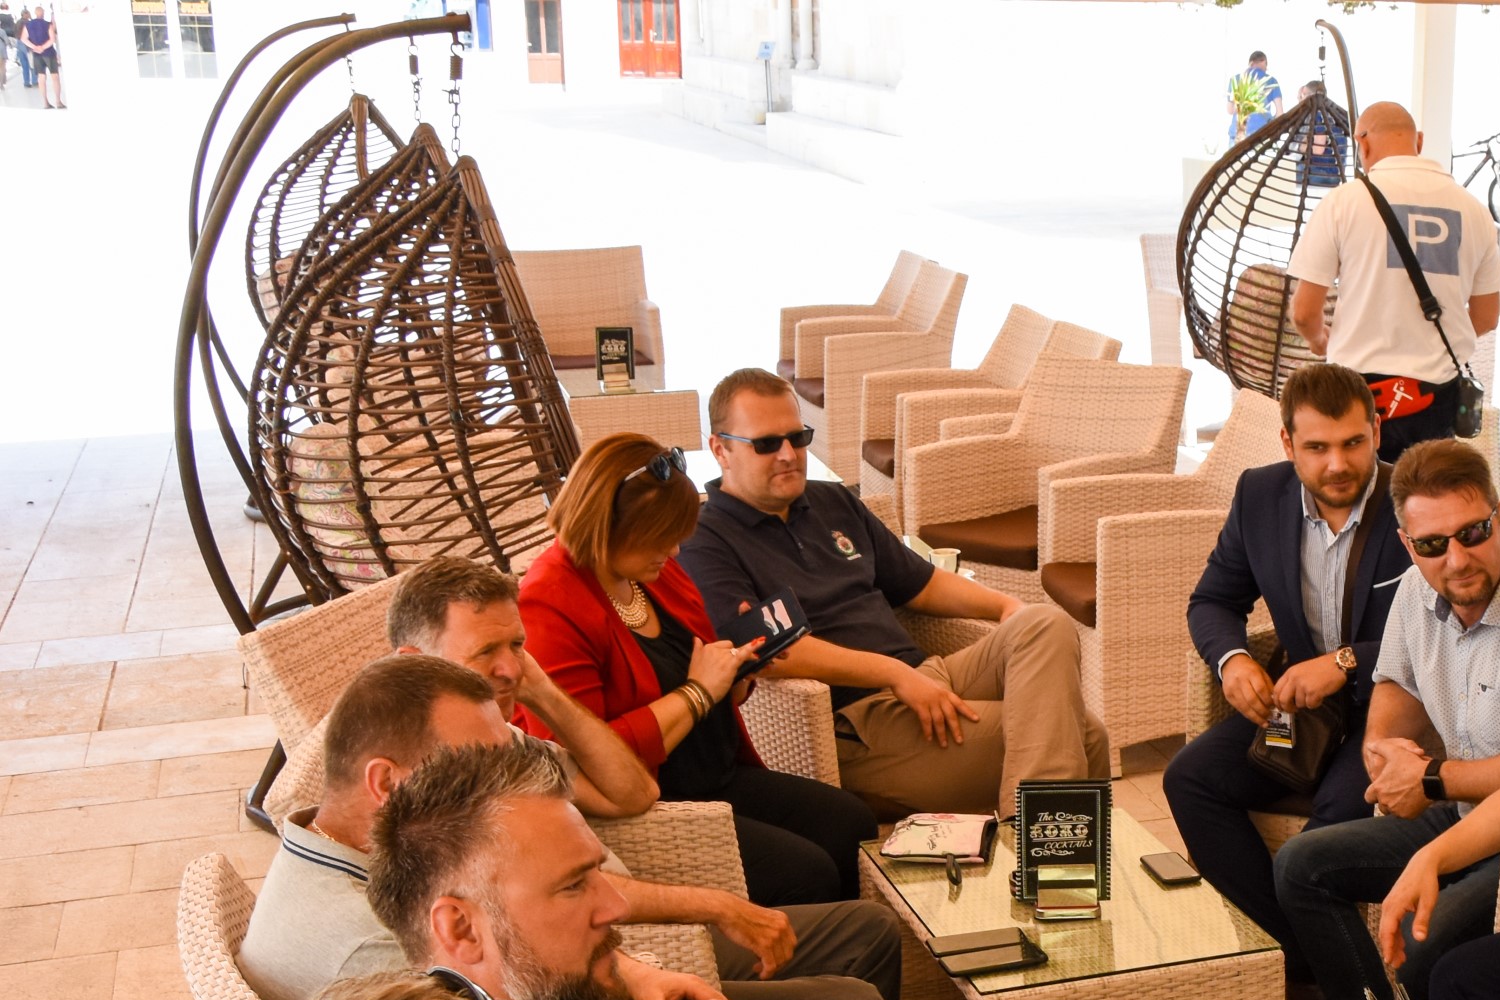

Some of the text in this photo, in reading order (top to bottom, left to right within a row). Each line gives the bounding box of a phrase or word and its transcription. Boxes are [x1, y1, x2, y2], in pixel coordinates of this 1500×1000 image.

[1407, 213, 1450, 256] P
[1037, 811, 1054, 822] The
[1044, 840, 1094, 849] COCKTAILS
